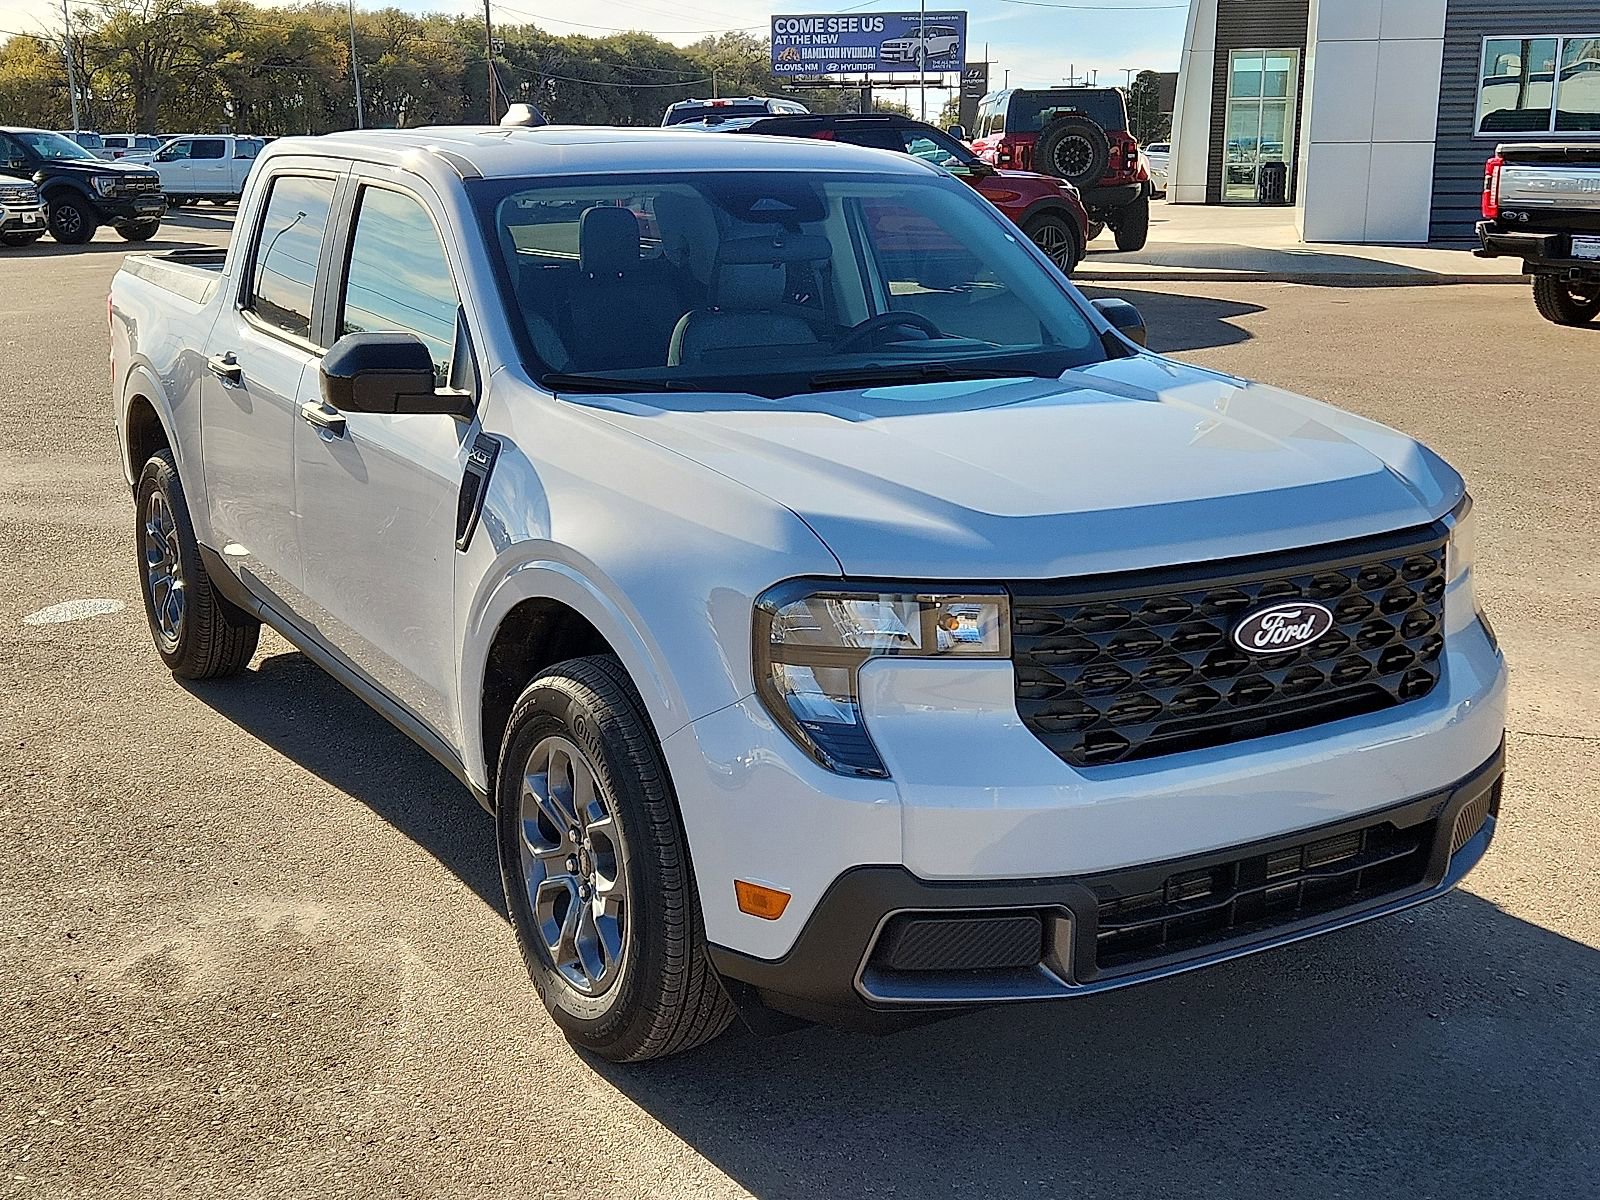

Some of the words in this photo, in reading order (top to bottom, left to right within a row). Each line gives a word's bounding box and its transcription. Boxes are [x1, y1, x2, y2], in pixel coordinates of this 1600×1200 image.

[774, 18, 825, 34] COME
[827, 17, 859, 33] SEE
[861, 17, 884, 32] US
[774, 35, 788, 45] AT
[790, 34, 811, 45] THE
[812, 34, 839, 44] NEW
[801, 47, 840, 59] HAMILTON
[840, 47, 877, 58] HYUNDAI
[774, 63, 804, 72] CLOVIS,
[805, 63, 819, 71] NM
[840, 63, 876, 71] HYUNDAI
[468, 447, 491, 464] XLT
[1254, 610, 1316, 647] Ford
